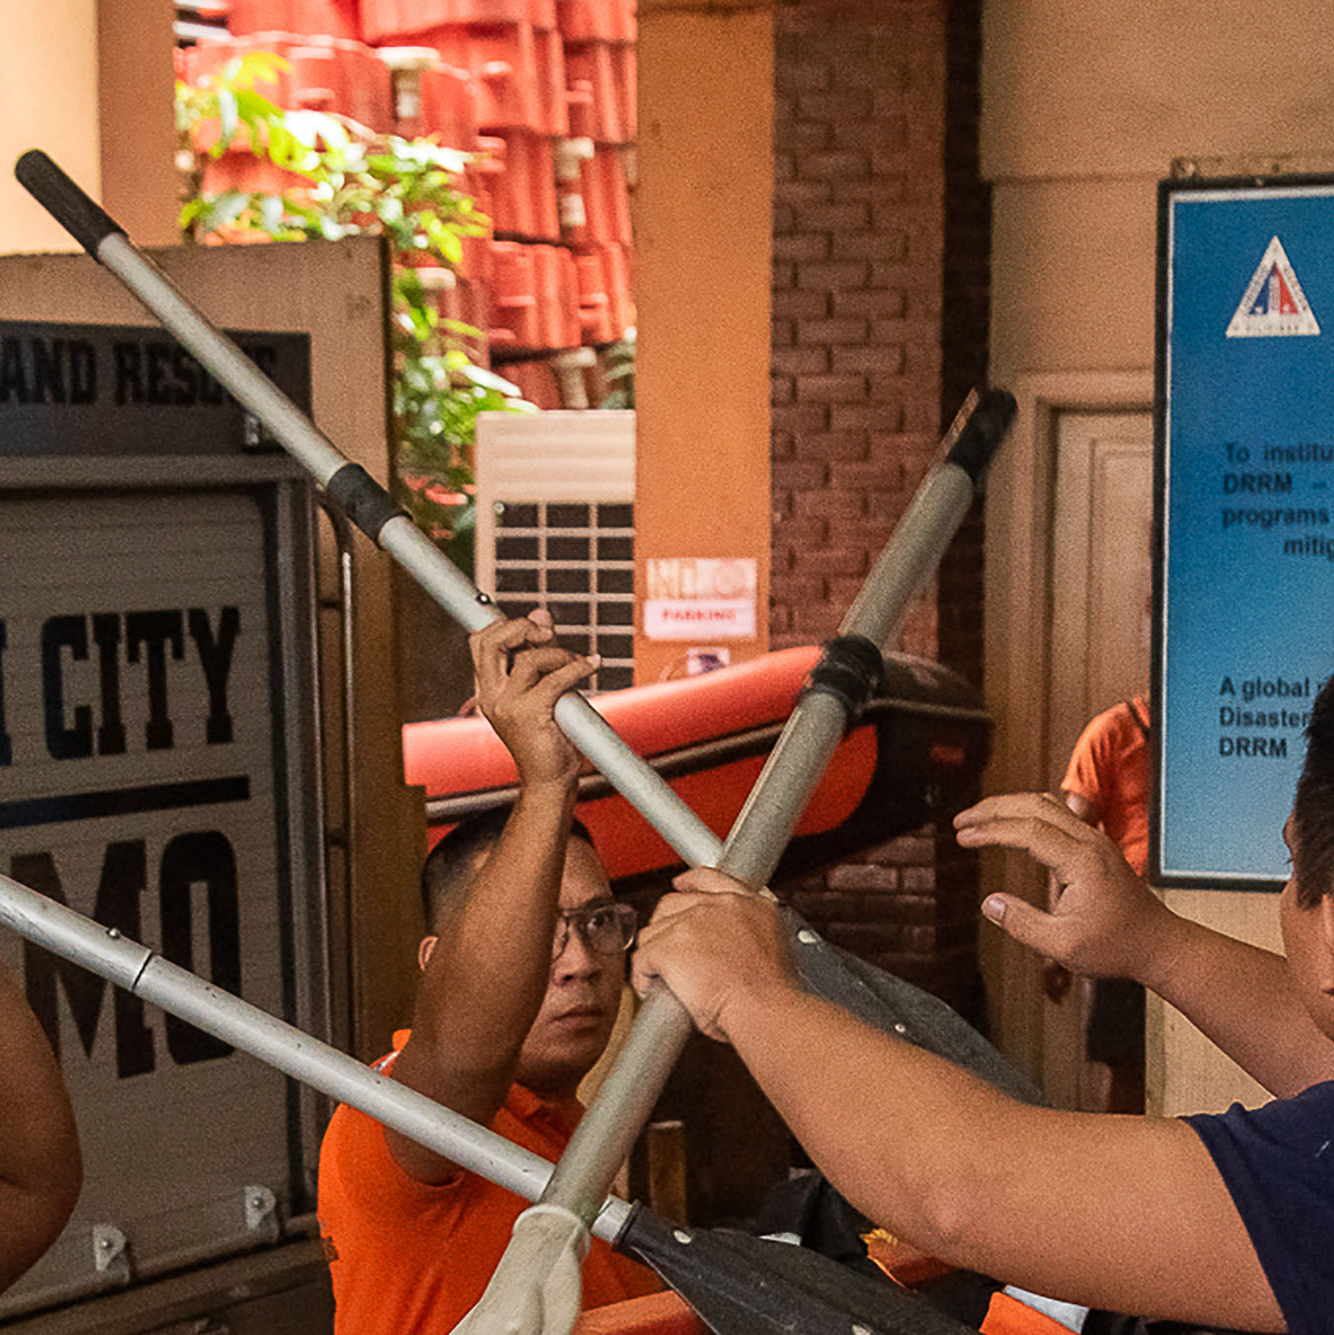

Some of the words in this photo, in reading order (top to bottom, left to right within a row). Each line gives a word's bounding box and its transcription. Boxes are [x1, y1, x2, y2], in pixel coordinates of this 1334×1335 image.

[1223, 442, 1250, 463] To
[1223, 473, 1293, 494] DRRM
[1222, 506, 1329, 531] programs
[41, 606, 242, 763] CITY
[1219, 676, 1235, 696] A
[1242, 676, 1310, 703] global
[1220, 706, 1308, 727] Disaster
[1219, 737, 1287, 757] DRRM
